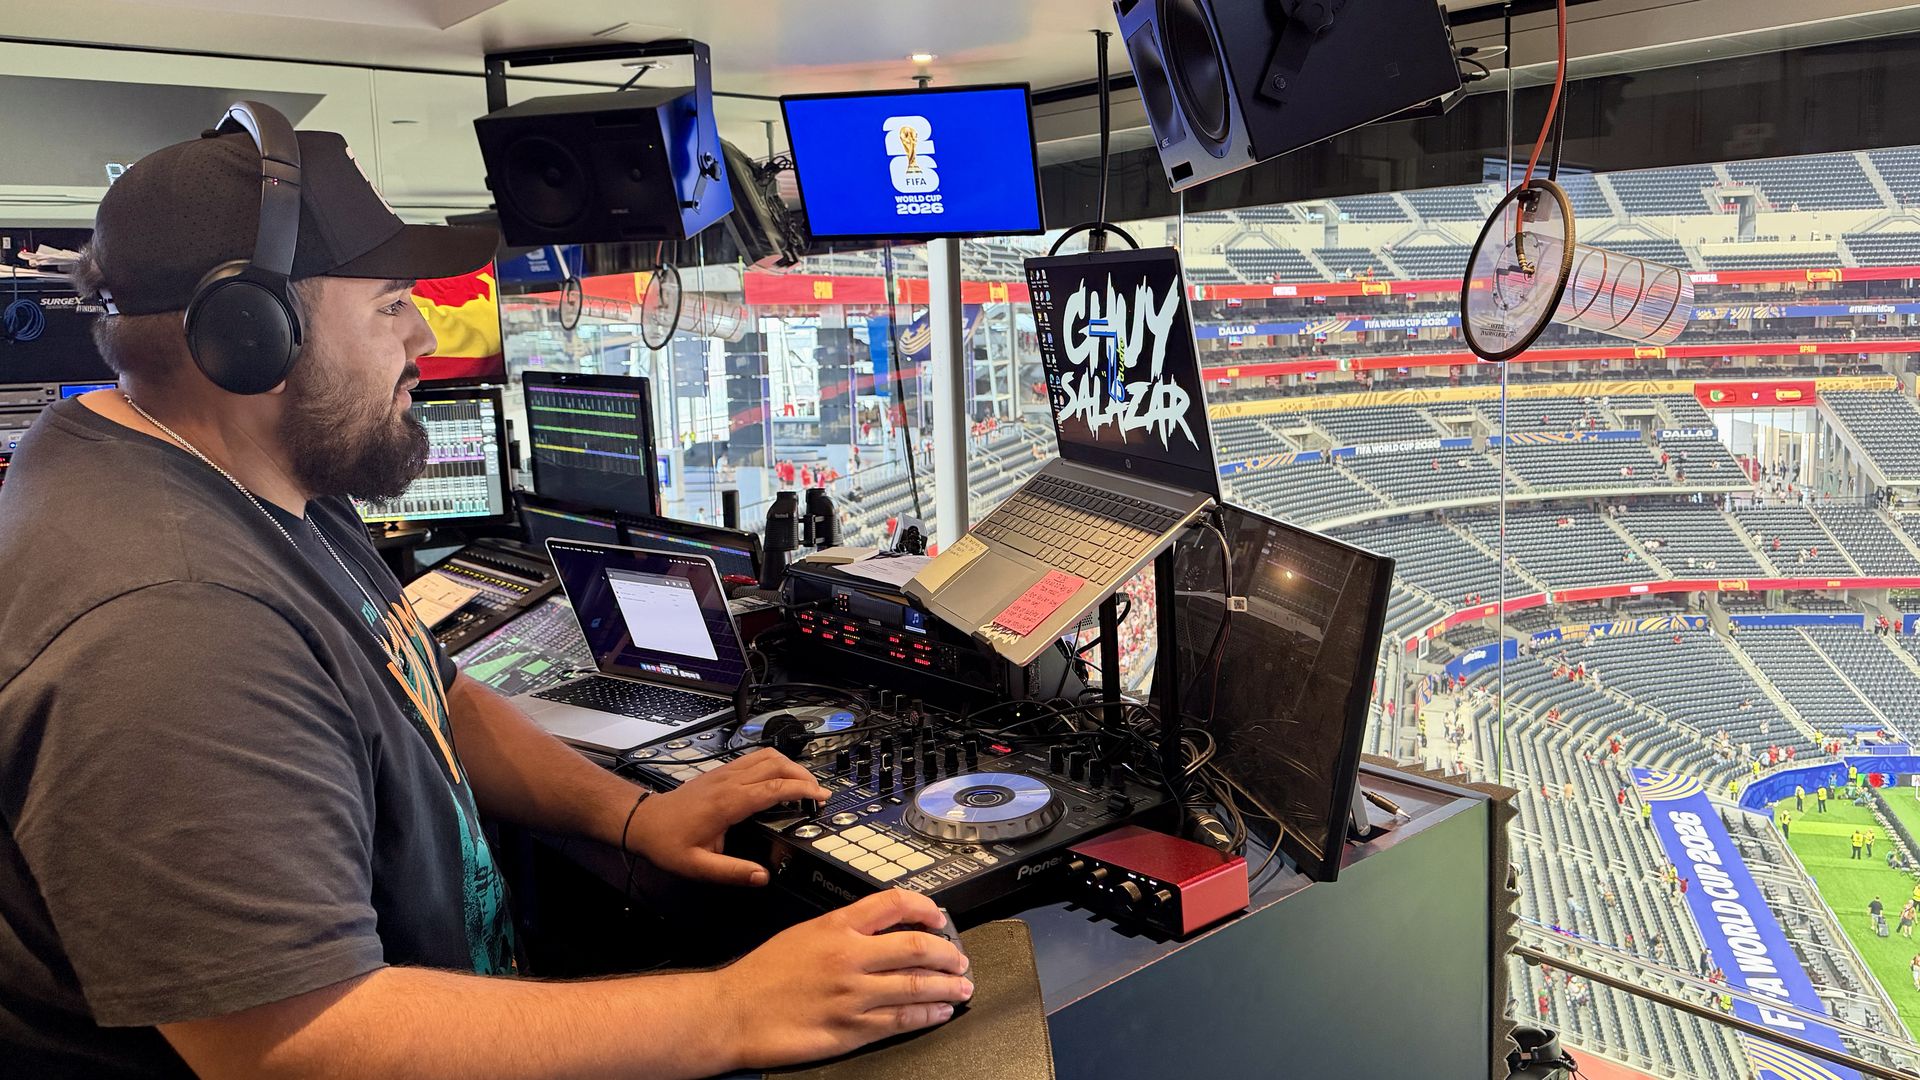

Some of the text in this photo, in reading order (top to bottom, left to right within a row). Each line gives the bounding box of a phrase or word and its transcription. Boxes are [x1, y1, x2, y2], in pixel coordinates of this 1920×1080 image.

[905, 178, 927, 186] FIFA
[896, 203, 944, 215] 2026
[1218, 325, 1256, 336] DALLAS
[1364, 317, 1449, 329] FIFA WORLD CUP 2026
[1059, 367, 1199, 452] SALAZAR
[1662, 430, 1713, 438] DALLAS
[1355, 440, 1441, 455] FIFA WORLD CUP 2026
[1668, 811, 1722, 866] 2026
[1017, 855, 1063, 880] Pione
[812, 870, 857, 900] Pione
[1693, 863, 1739, 900] CUP
[1711, 900, 1777, 973] WORLD
